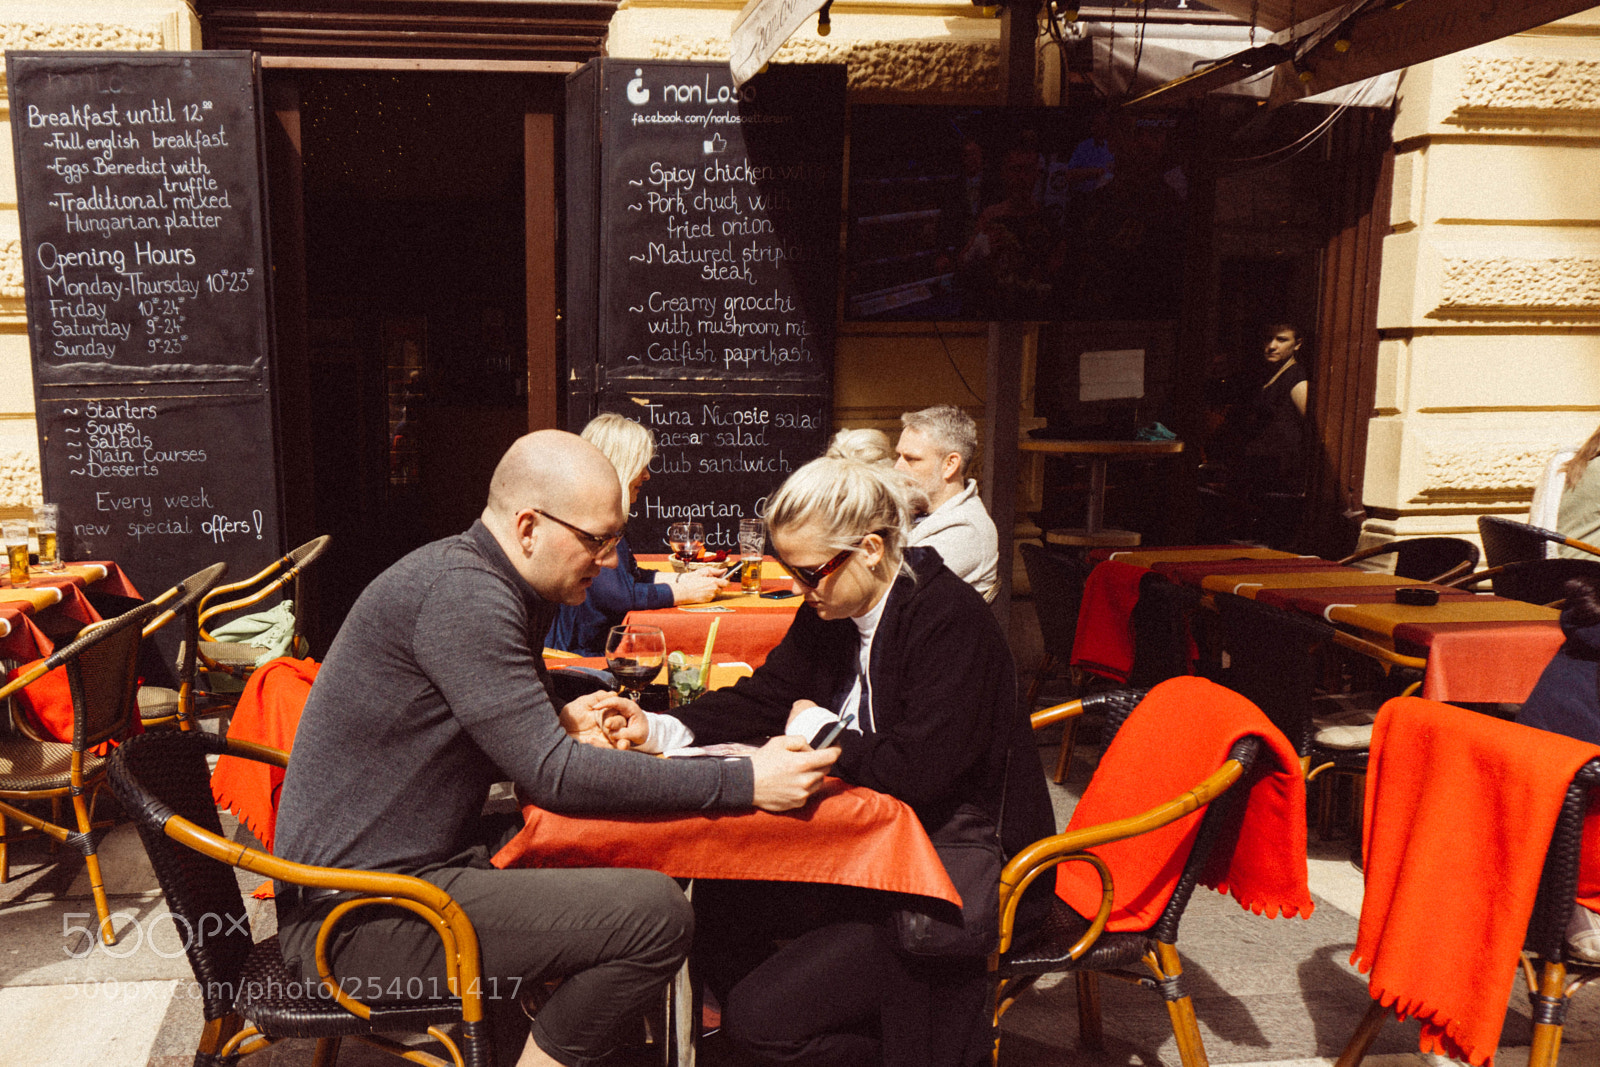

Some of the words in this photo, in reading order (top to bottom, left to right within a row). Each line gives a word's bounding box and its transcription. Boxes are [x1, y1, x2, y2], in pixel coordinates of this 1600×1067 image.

[28, 103, 121, 130] Breakfast
[127, 98, 176, 124] until
[87, 130, 140, 160] english
[152, 125, 229, 153] breakfast
[93, 156, 167, 175] Benedict
[171, 156, 211, 175] with
[648, 162, 696, 192] Spicy
[704, 157, 775, 184] chicken
[163, 176, 218, 199] truffle
[174, 190, 231, 209] mixed
[647, 188, 688, 214] Pork
[693, 188, 742, 215] chuck
[65, 213, 160, 238] Hungarian
[164, 210, 222, 235] platter
[667, 215, 715, 239] fried
[722, 216, 774, 236] onion
[38, 242, 125, 274] Opening
[135, 241, 195, 265] Hours
[646, 241, 736, 264] Matured
[701, 261, 757, 285] steak
[50, 294, 107, 320] Friday
[648, 291, 717, 317] Creamy
[723, 288, 796, 320] gnocchi
[51, 318, 131, 341] Saturday
[648, 313, 692, 337] with
[698, 316, 781, 337] mushroom
[53, 340, 115, 359] Sunday
[647, 339, 717, 366] Catfish
[723, 338, 813, 369] paprikash
[85, 401, 157, 419] Starters
[644, 404, 694, 425] Tuna
[775, 408, 822, 429] salad
[85, 420, 135, 439] Soups
[86, 429, 153, 449] Salads
[716, 426, 769, 447] salad
[88, 448, 134, 463] Main
[143, 448, 207, 463] Courses
[648, 451, 691, 474] Club
[698, 449, 792, 473] sandwich
[87, 462, 159, 478] Desserts
[96, 491, 152, 516] Every
[164, 487, 214, 509] week
[645, 496, 744, 524] Hungarian
[74, 523, 110, 536] new
[127, 516, 193, 543] special
